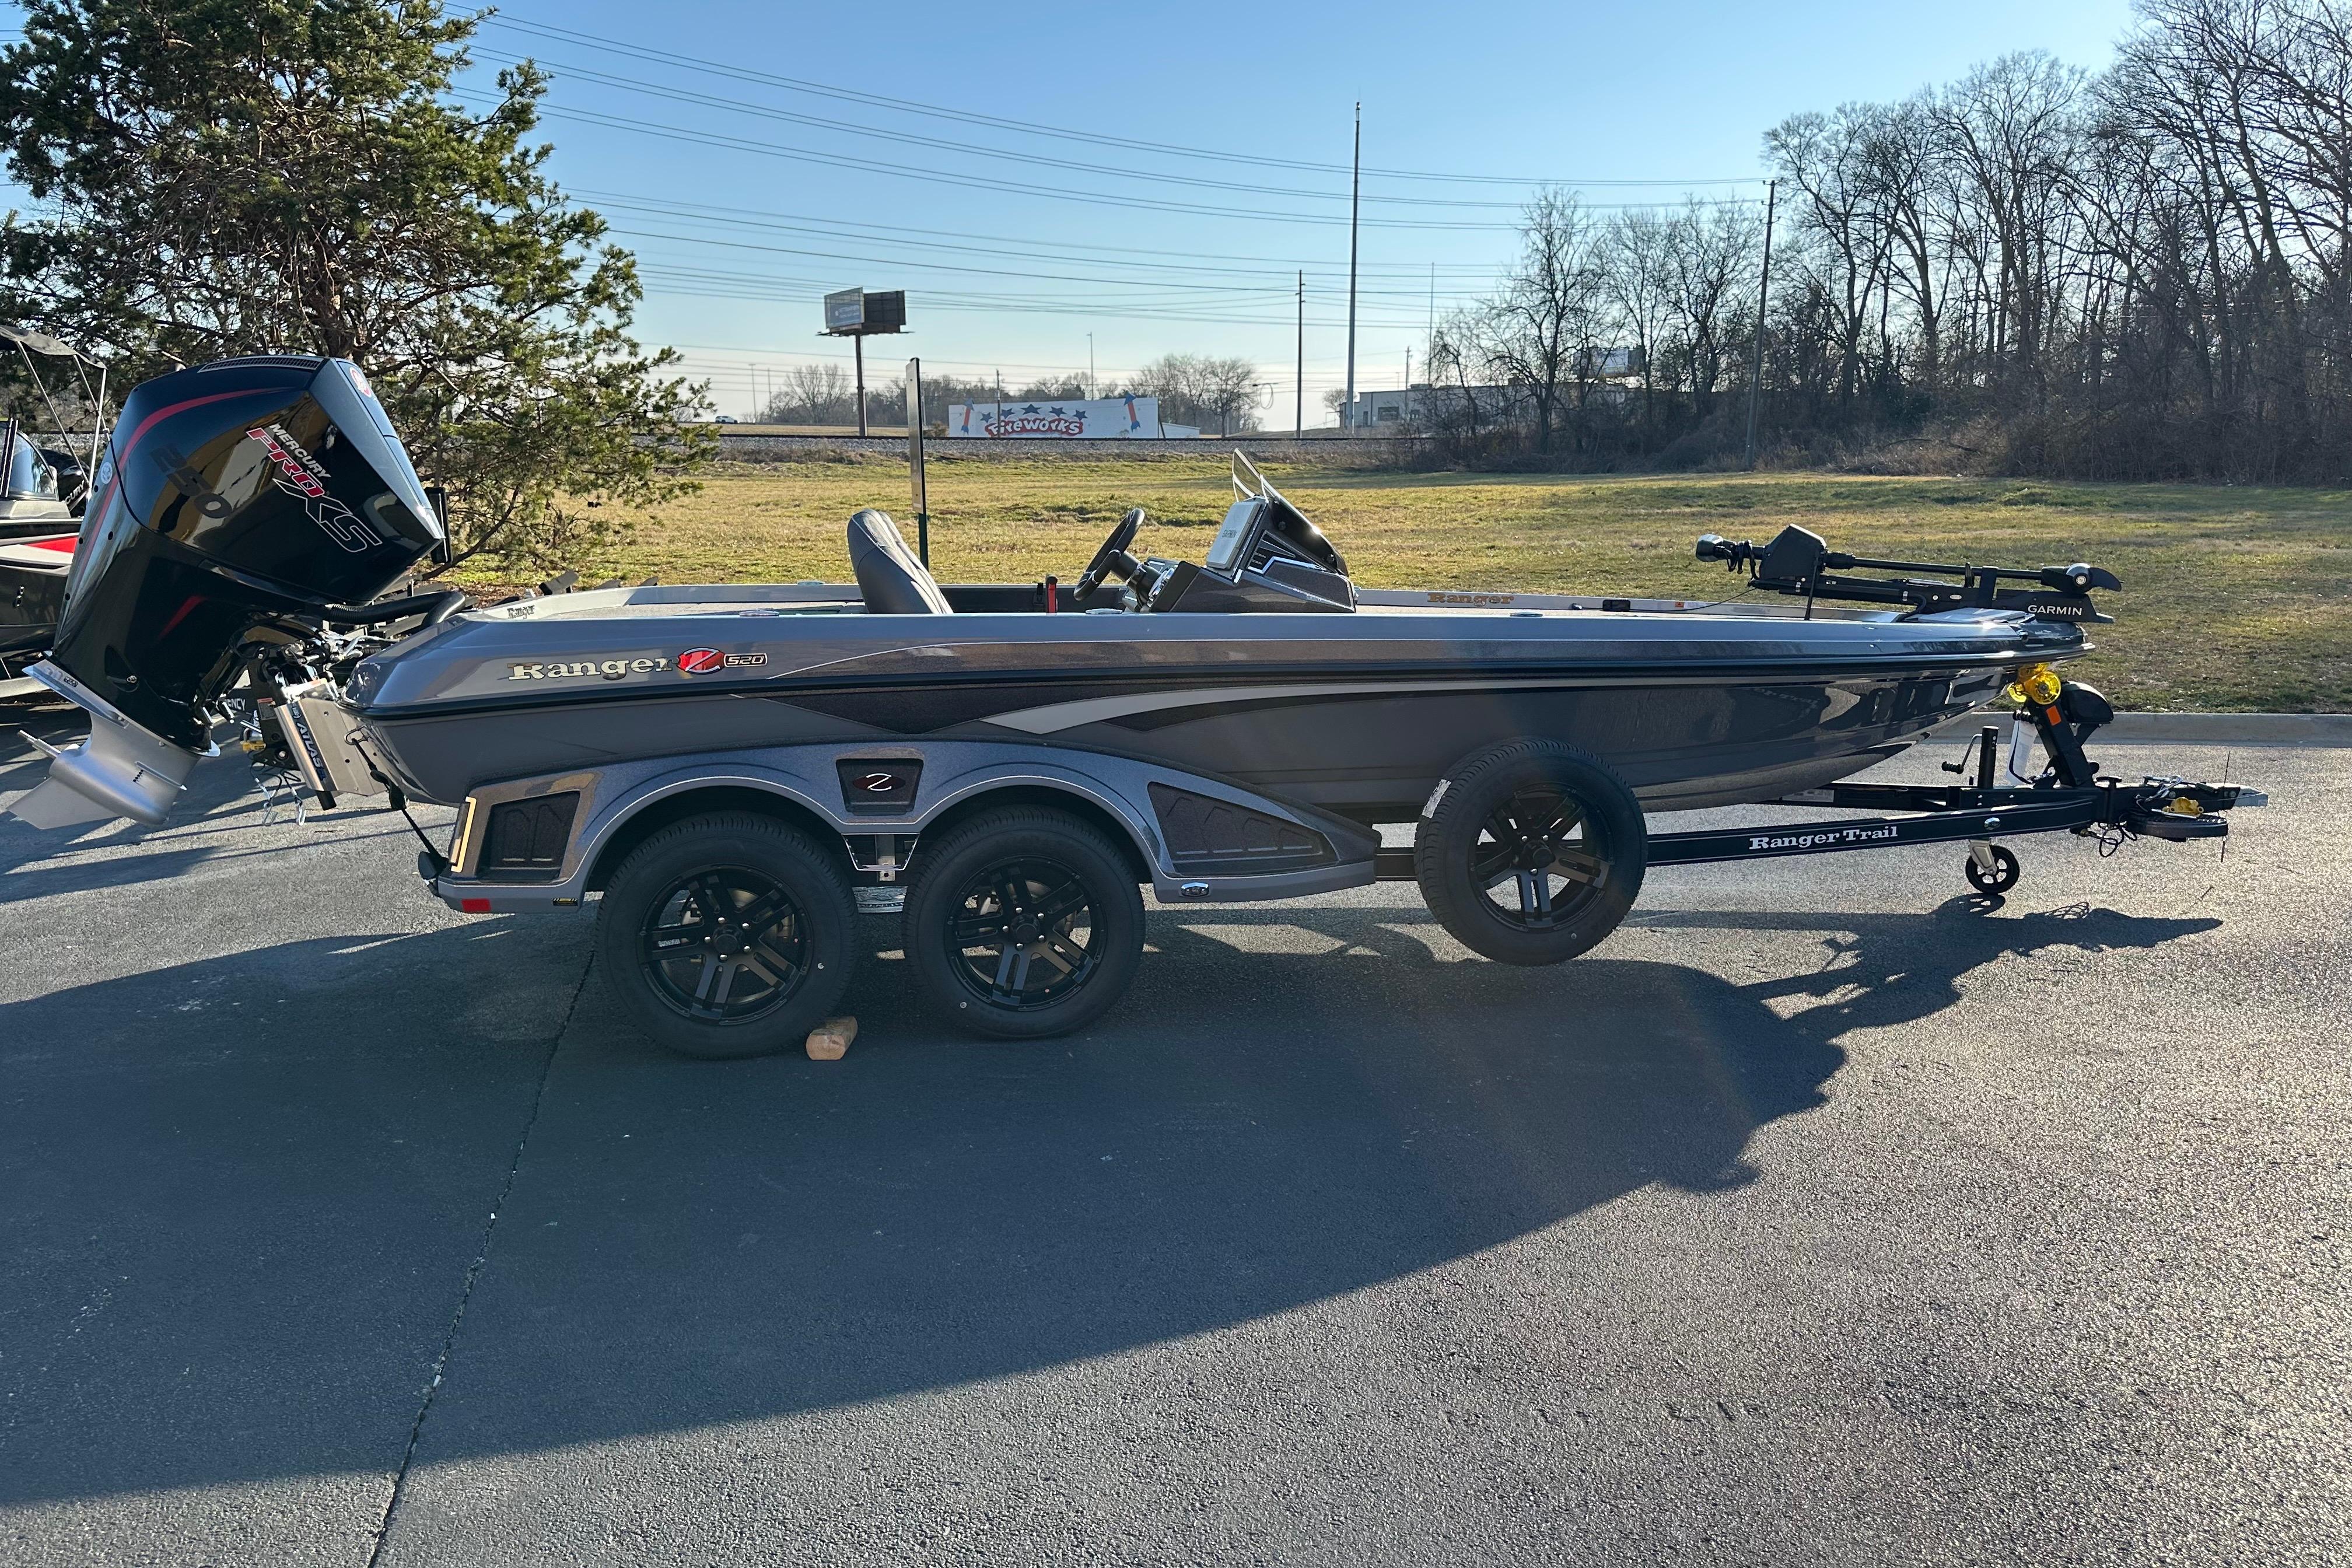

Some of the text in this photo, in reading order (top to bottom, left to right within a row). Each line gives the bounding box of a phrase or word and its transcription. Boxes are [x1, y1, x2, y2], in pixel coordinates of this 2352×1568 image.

[988, 419, 1080, 435] Fireworks
[270, 423, 331, 479] MERCURY
[64, 480, 85, 505] CURY
[149, 443, 234, 519] 250
[246, 428, 383, 552] PRO XS
[1427, 593, 1515, 607] Ranger
[2028, 604, 2082, 616] GARMIN
[507, 656, 679, 681] Ranger
[726, 654, 765, 666] 520
[226, 698, 246, 711] ENCY
[297, 722, 324, 768] ATLAS
[1749, 826, 1898, 849] Ranger Trail
